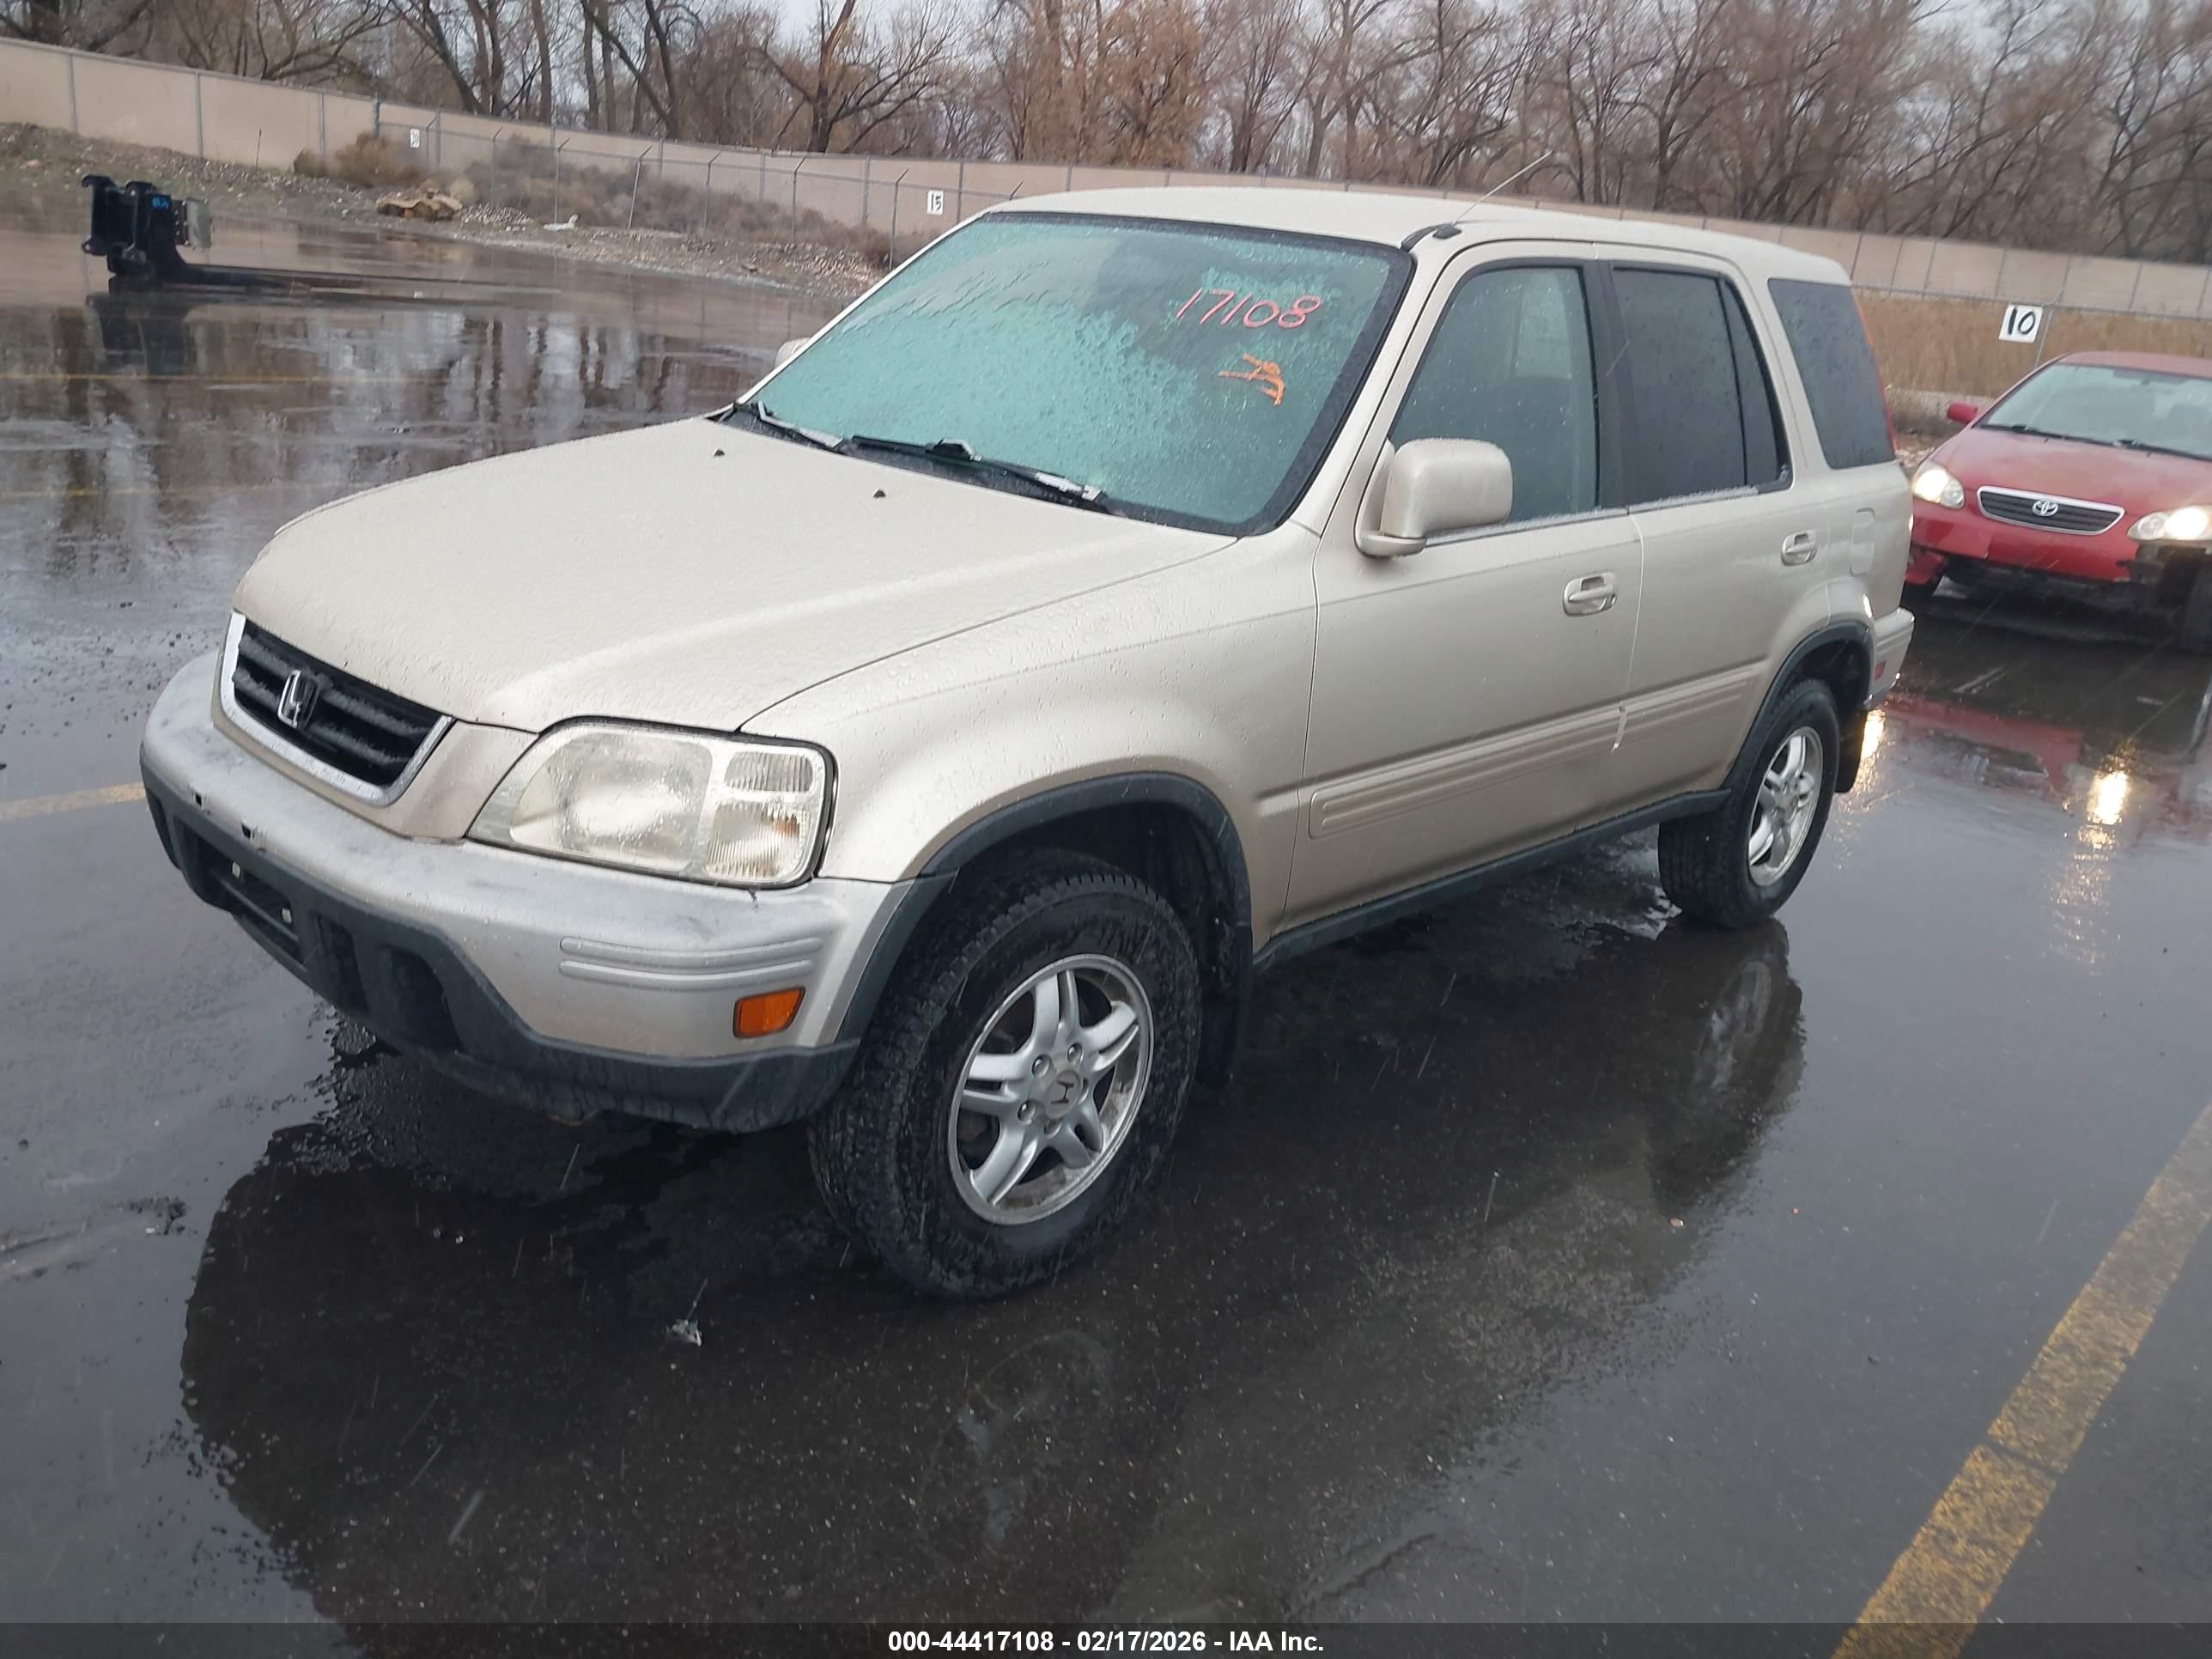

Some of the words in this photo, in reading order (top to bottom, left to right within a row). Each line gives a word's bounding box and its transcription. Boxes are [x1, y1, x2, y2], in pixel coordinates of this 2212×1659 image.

[931, 193, 942, 211] 15
[1176, 288, 1322, 329] 17108
[2008, 305, 2036, 335] 10
